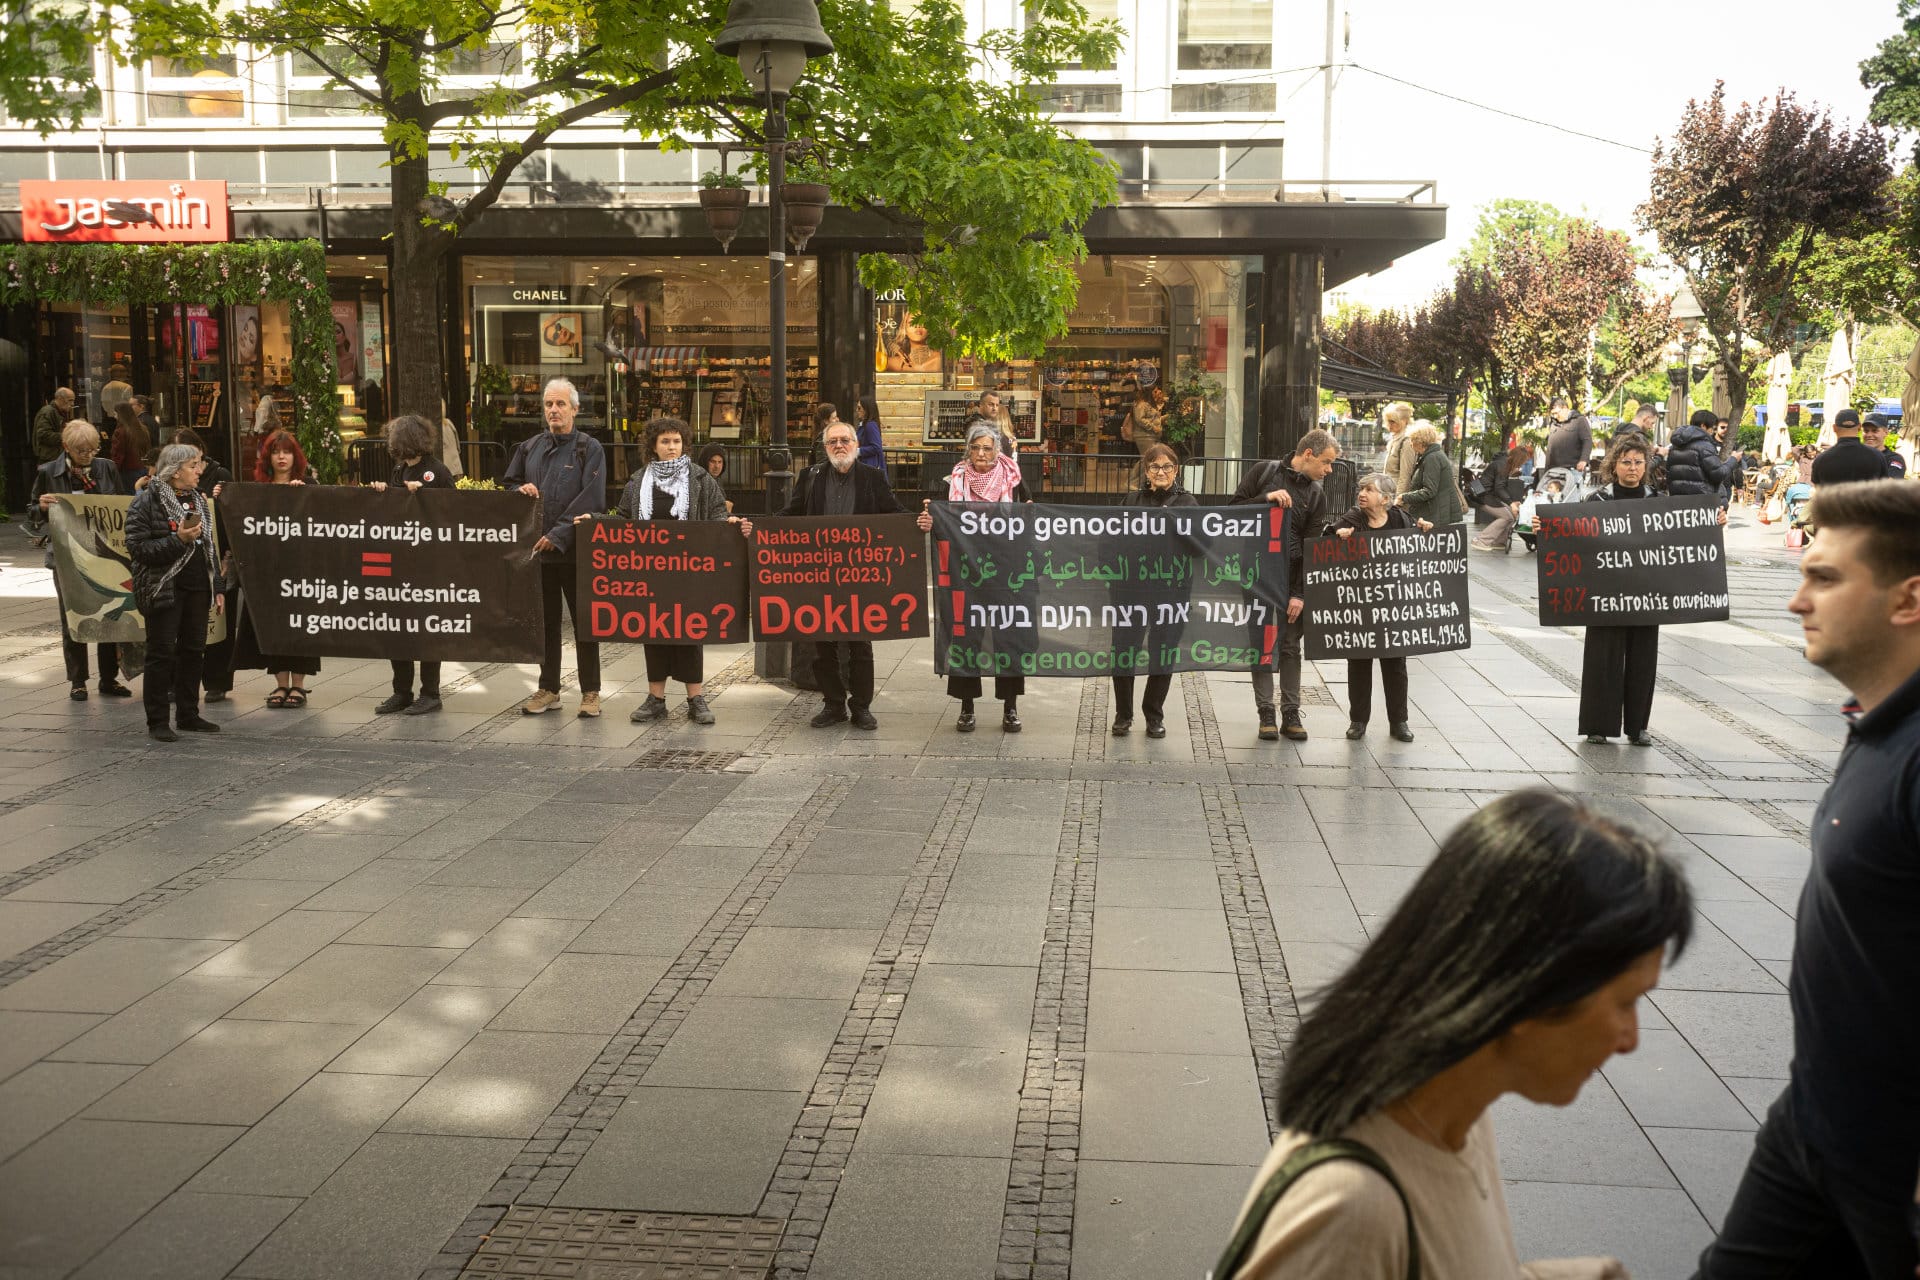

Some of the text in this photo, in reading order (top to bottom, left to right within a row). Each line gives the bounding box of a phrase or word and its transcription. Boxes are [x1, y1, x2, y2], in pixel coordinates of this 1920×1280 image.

[513, 290, 567, 300] CHANEL
[243, 516, 518, 546] Srbija izvozi oružje u Izrael
[591, 522, 670, 545] Aušvic
[757, 529, 811, 545] Nakba
[815, 527, 872, 548] (1948.)
[960, 511, 1025, 540] Stop
[1034, 512, 1166, 542] genocidu
[1176, 517, 1192, 537] u
[1201, 513, 1262, 537] Gazi
[1540, 515, 1599, 541] 750.000
[757, 548, 843, 567] Okupacija
[848, 546, 905, 566] (1967.)
[1312, 529, 1461, 564] NAKBA (KATASTROFA)
[592, 549, 715, 572] Srebrenica
[960, 551, 998, 588] غزة
[1007, 551, 1036, 593] في
[1043, 550, 1129, 588] الجماعية
[1545, 551, 1582, 577] 500
[1596, 551, 1634, 569] SELA
[592, 575, 655, 597] Gaza.
[758, 566, 892, 587] Genocid (2023.)
[280, 579, 481, 605] Srbija je saučesnica
[1547, 586, 1587, 614] 78%
[289, 611, 472, 635] u genocidu u Gazi
[591, 601, 736, 640] Dokle?
[759, 593, 918, 635] Dokle?
[970, 604, 1032, 630] בעזה
[1041, 604, 1091, 631] העם
[1101, 603, 1148, 627] רצח
[1156, 601, 1190, 625] את
[1198, 598, 1267, 627] לעצור
[1312, 608, 1363, 626] NAKON
[1324, 631, 1377, 649] DRŽAVE
[948, 643, 1012, 674] Stop
[1020, 646, 1150, 675] genocide
[1160, 644, 1181, 667] in
[1190, 639, 1260, 666] Gaza
